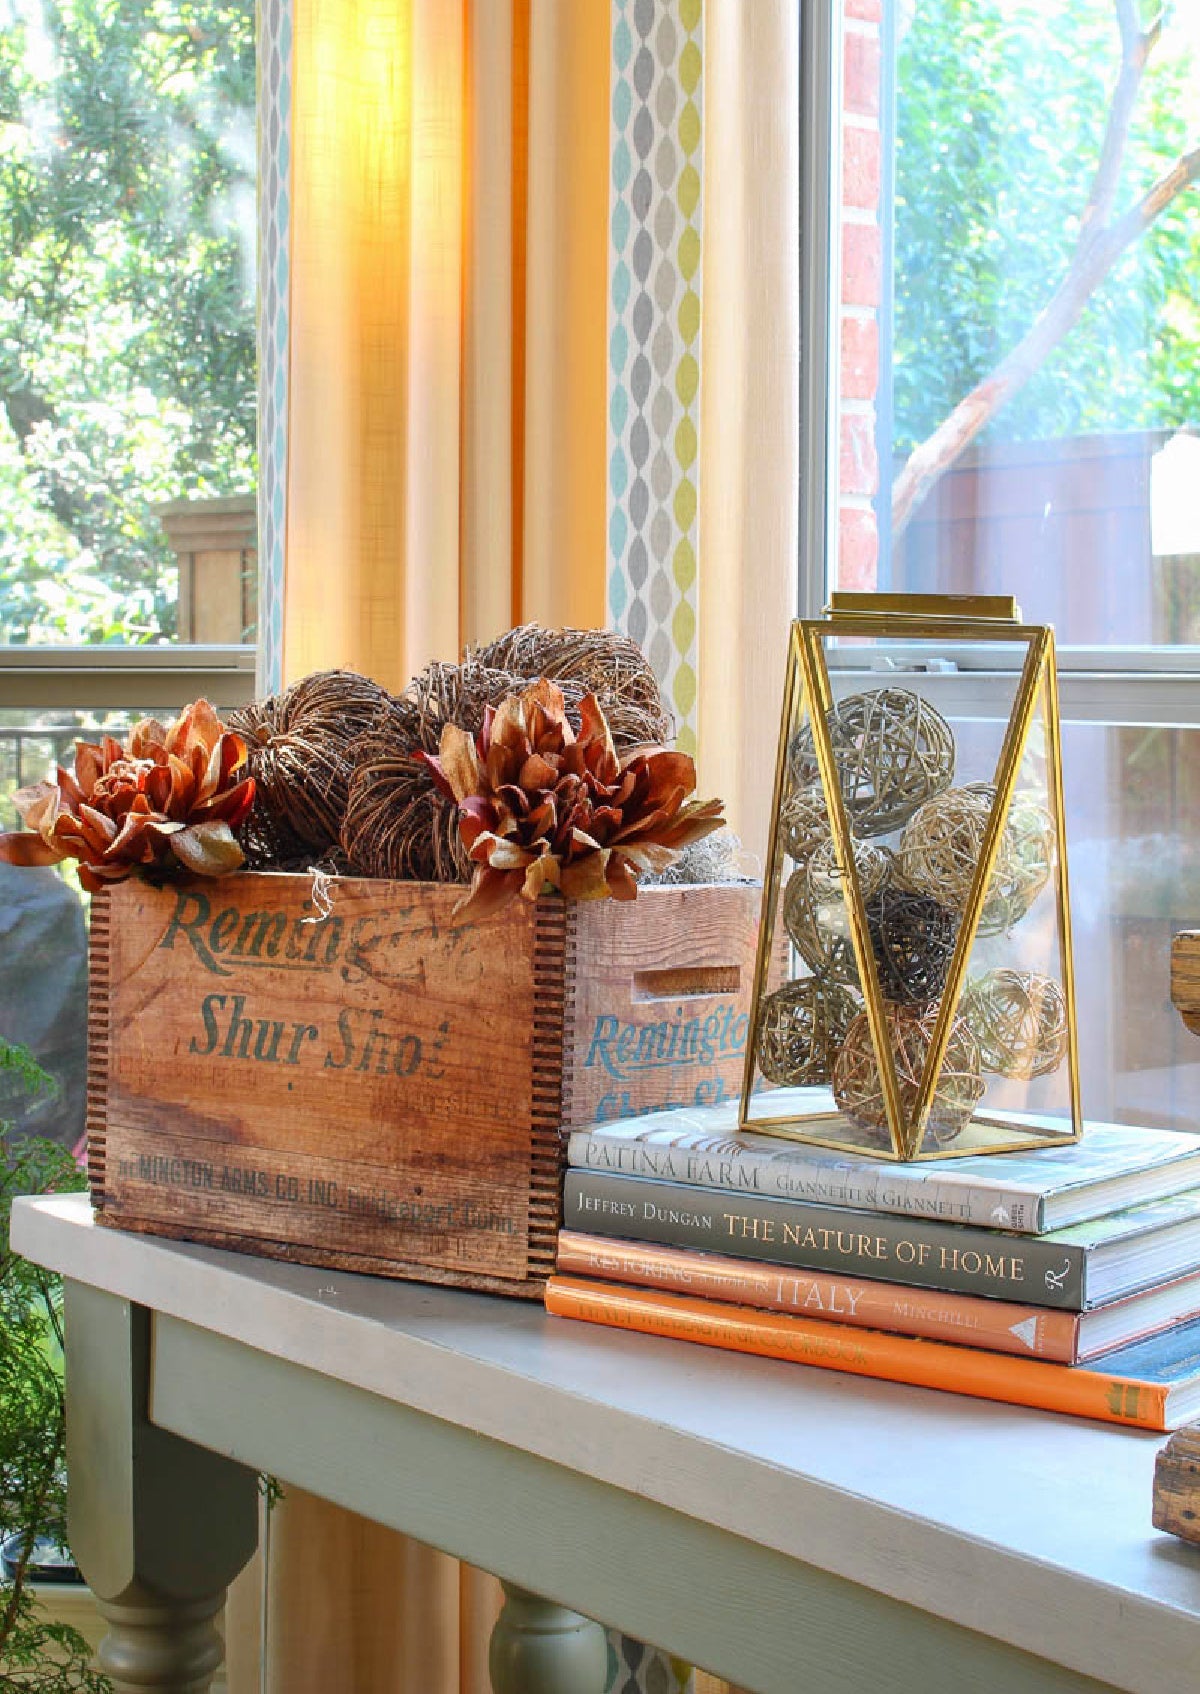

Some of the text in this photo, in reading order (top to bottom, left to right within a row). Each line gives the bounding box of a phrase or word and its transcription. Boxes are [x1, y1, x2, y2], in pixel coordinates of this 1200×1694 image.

[188, 994, 319, 1065] Shur
[583, 1003, 750, 1081] Remingto
[222, 1164, 269, 1197] ARMS
[585, 1141, 973, 1218] PATINA FARM GIANNETTI & GIANNETTI
[577, 1192, 1025, 1281] JEFFREY DUNGAN THE NATURE OF HOME
[774, 1274, 866, 1317] ITALY
